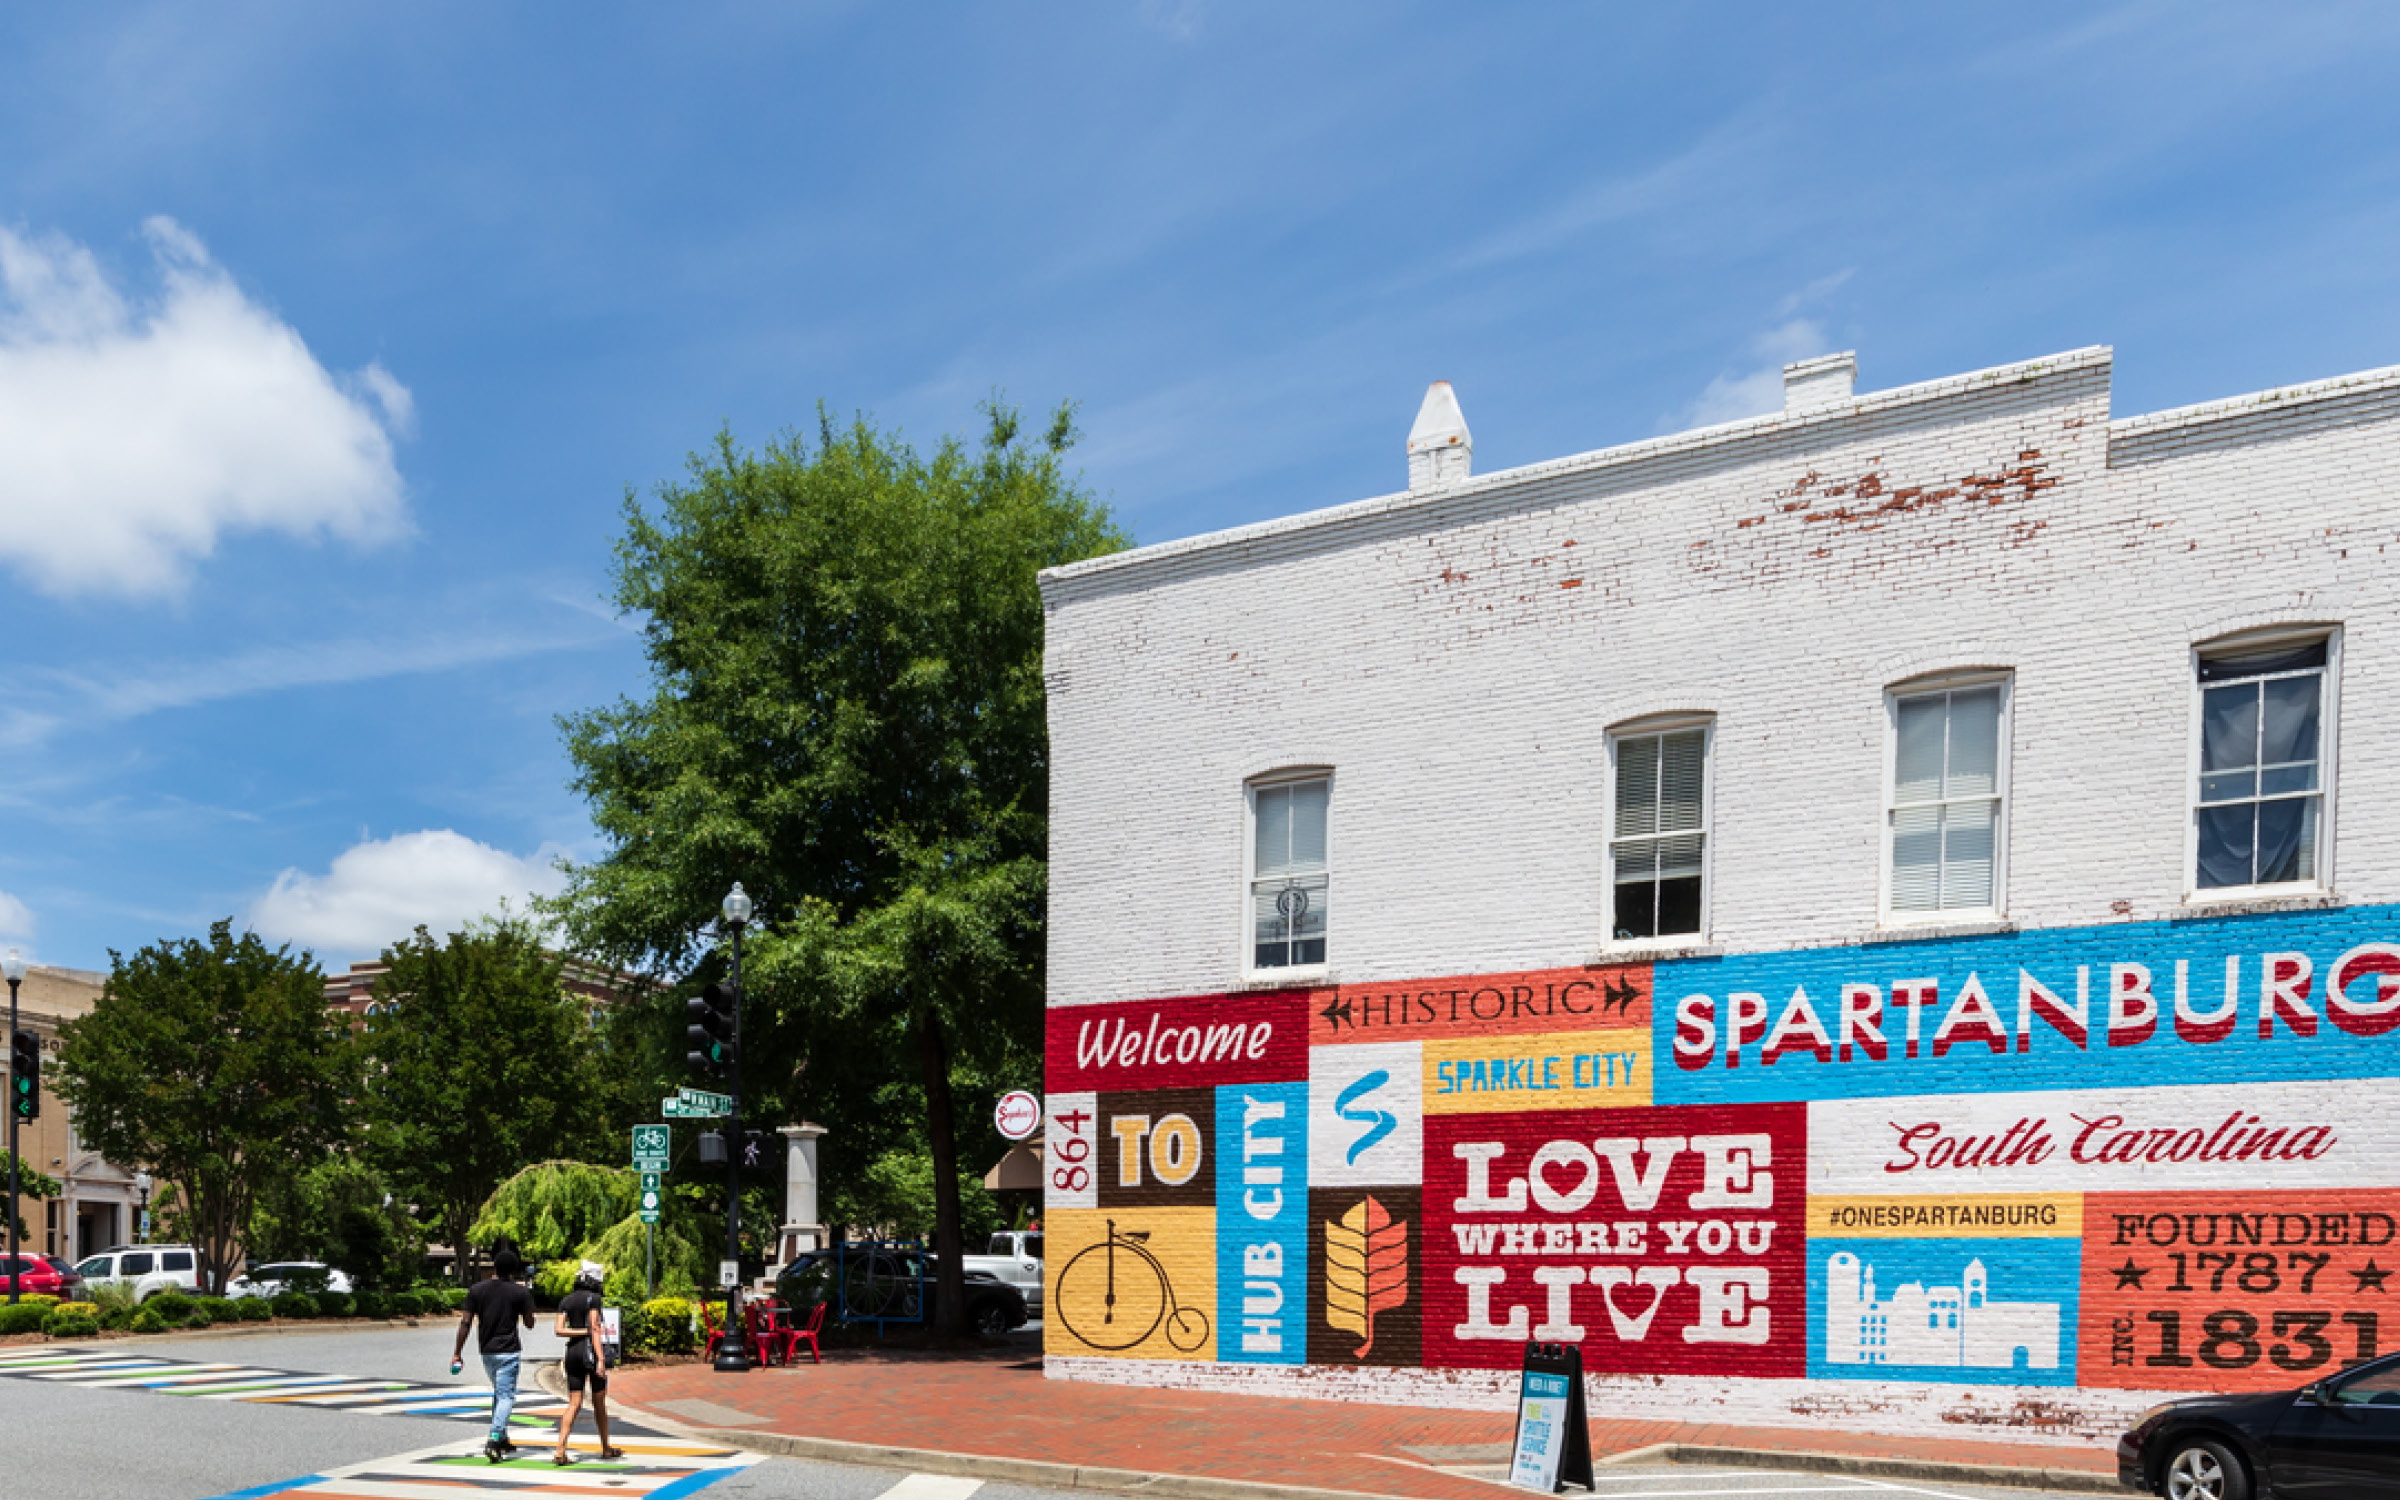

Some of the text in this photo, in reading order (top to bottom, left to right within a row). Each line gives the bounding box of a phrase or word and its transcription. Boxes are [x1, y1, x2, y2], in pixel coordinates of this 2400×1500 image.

[1361, 980, 1597, 1028] HISTORIC
[1672, 942, 2400, 1071] SPARTANBURG
[1076, 1012, 1273, 1070] Welcome
[1437, 1052, 1636, 1094] SPARKLE CITY
[1052, 1108, 1092, 1193] 864
[1111, 1112, 1202, 1187] TO
[1883, 1109, 2338, 1174] South Carolina
[1452, 1132, 1775, 1214] LOVE
[1241, 1094, 1286, 1353] HUB CITY
[1450, 1221, 1777, 1256] WHERE YOU
[1829, 1204, 2057, 1228] #ONESPARTANBURG
[2110, 1212, 2396, 1247] FOUNDED
[2165, 1252, 2331, 1294] 1787
[1452, 1265, 1771, 1345] LIVE
[2112, 1310, 2134, 1367] INC.
[2145, 1309, 2378, 1371] 1831
